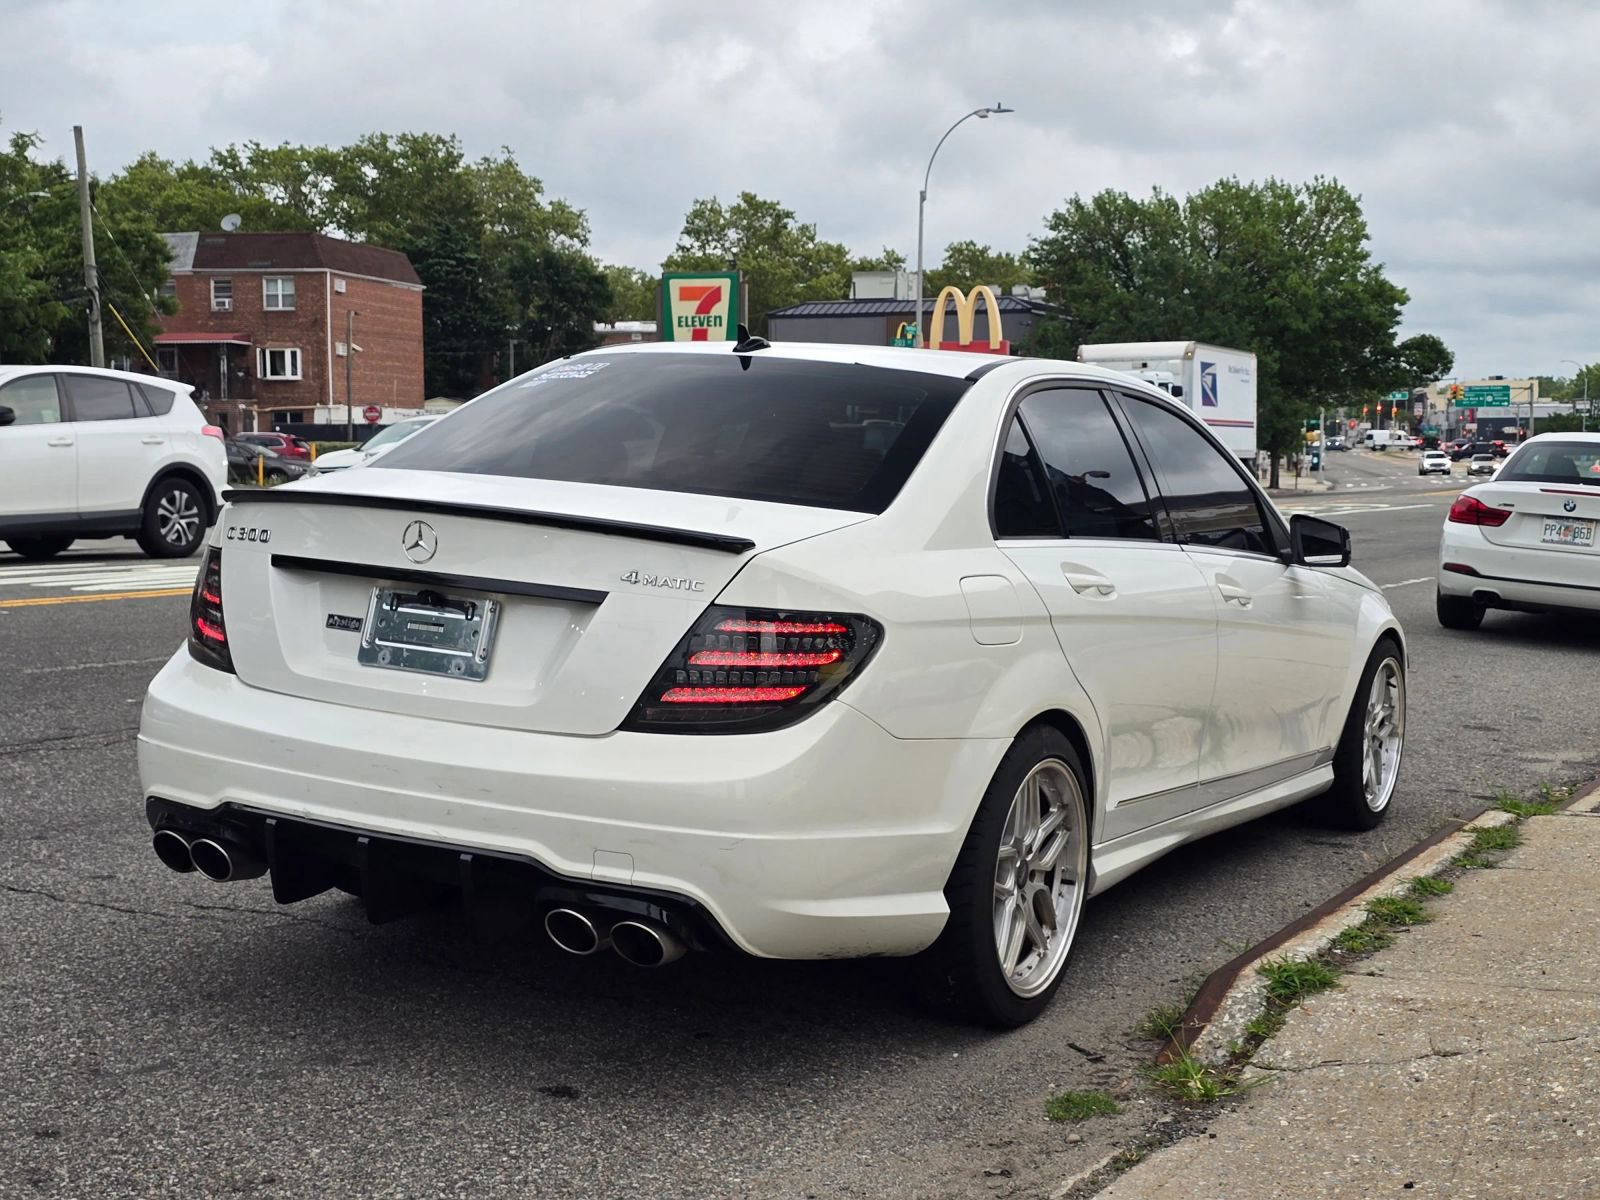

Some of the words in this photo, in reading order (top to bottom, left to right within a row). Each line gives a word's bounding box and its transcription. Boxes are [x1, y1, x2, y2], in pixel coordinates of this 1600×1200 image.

[679, 286, 722, 341] 7
[1543, 524, 1561, 537] PP4
[620, 571, 705, 592] 4MATIC
